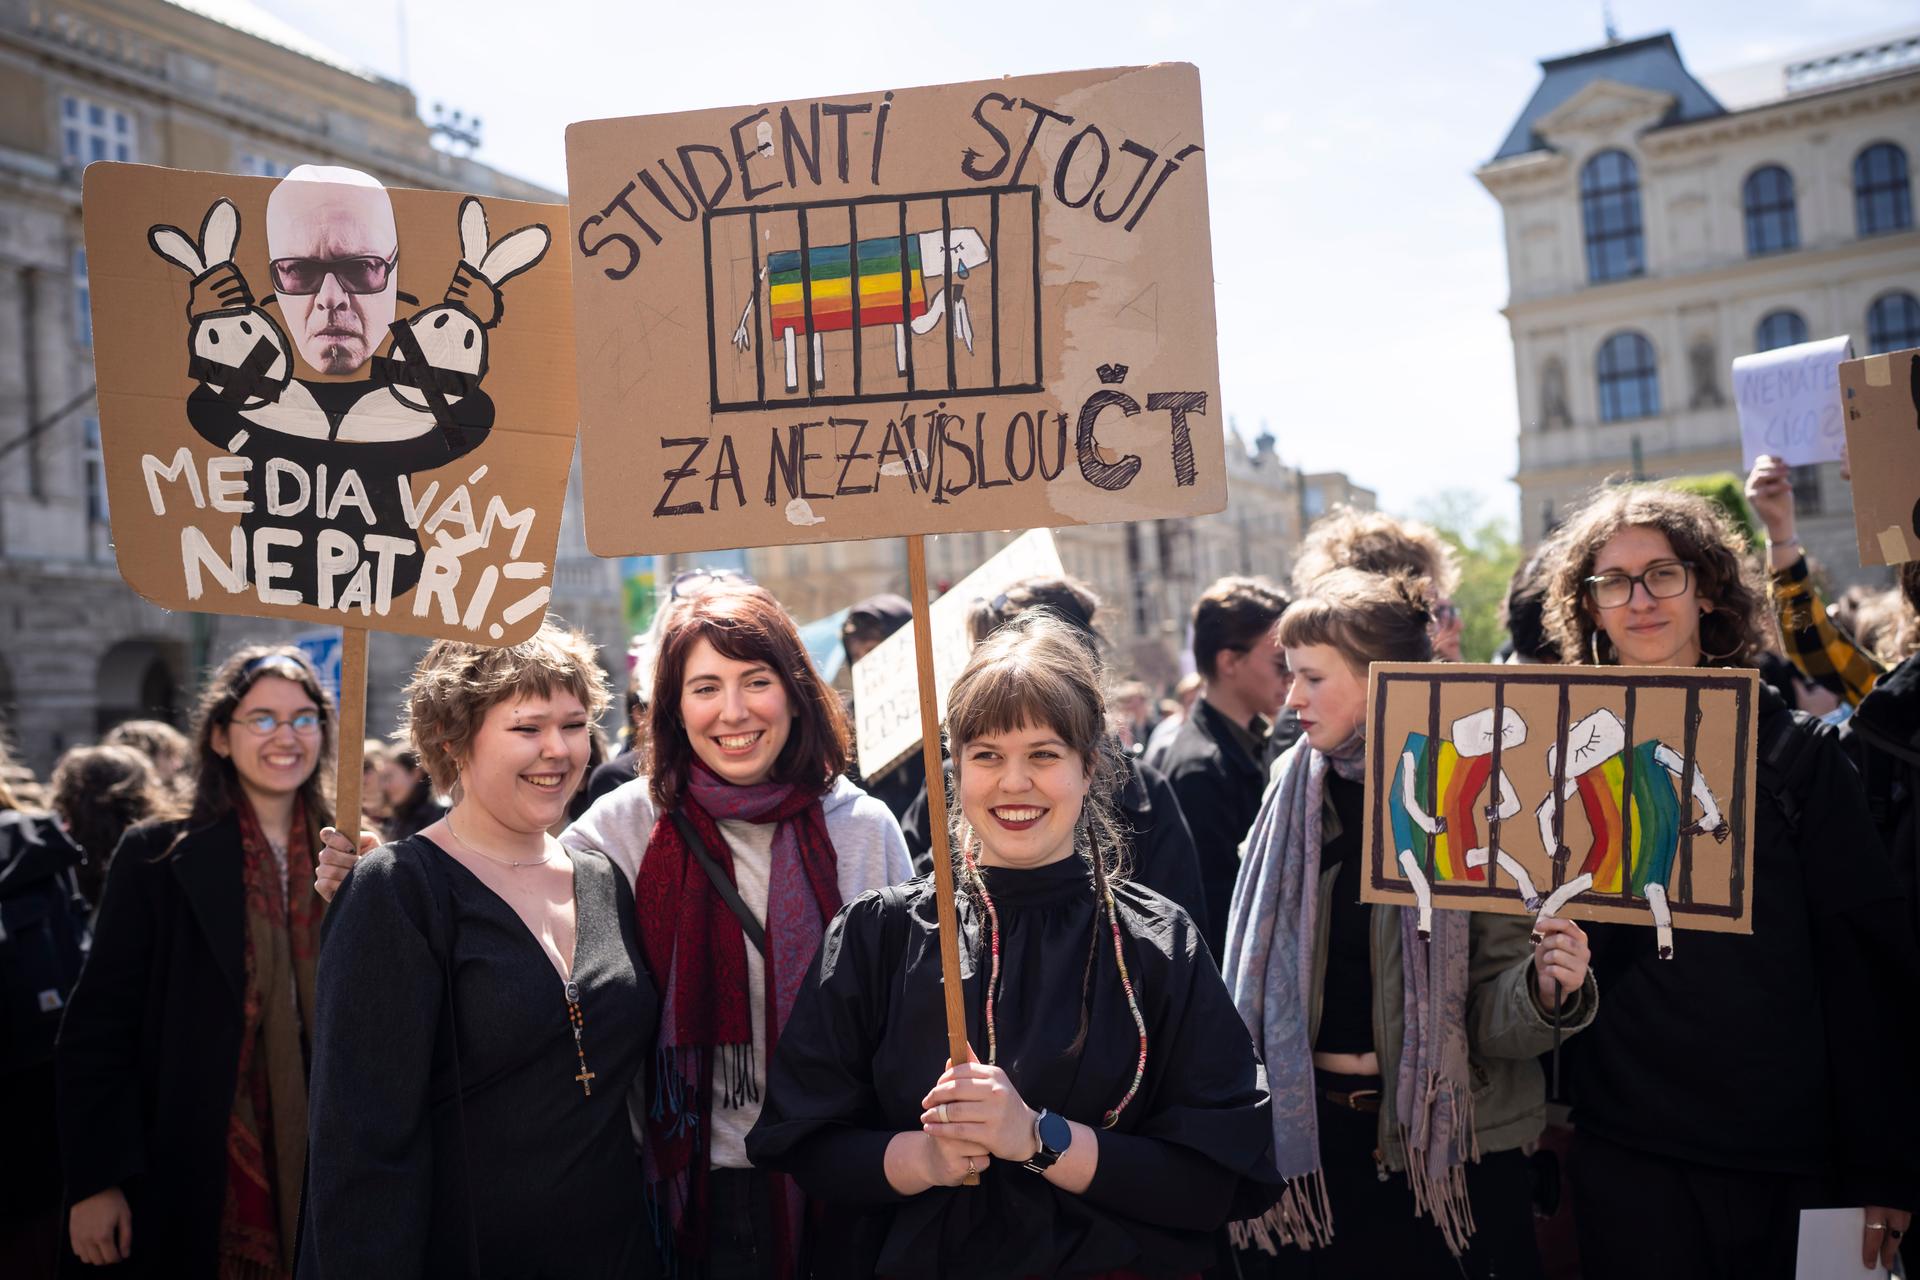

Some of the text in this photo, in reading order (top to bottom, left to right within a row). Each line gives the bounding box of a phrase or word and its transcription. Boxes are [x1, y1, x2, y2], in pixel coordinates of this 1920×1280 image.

[961, 92, 1206, 233] STOJÍ
[141, 428, 536, 559] MÉDIA VÁM
[653, 435, 747, 518] ZA
[1074, 363, 1208, 491] ČT
